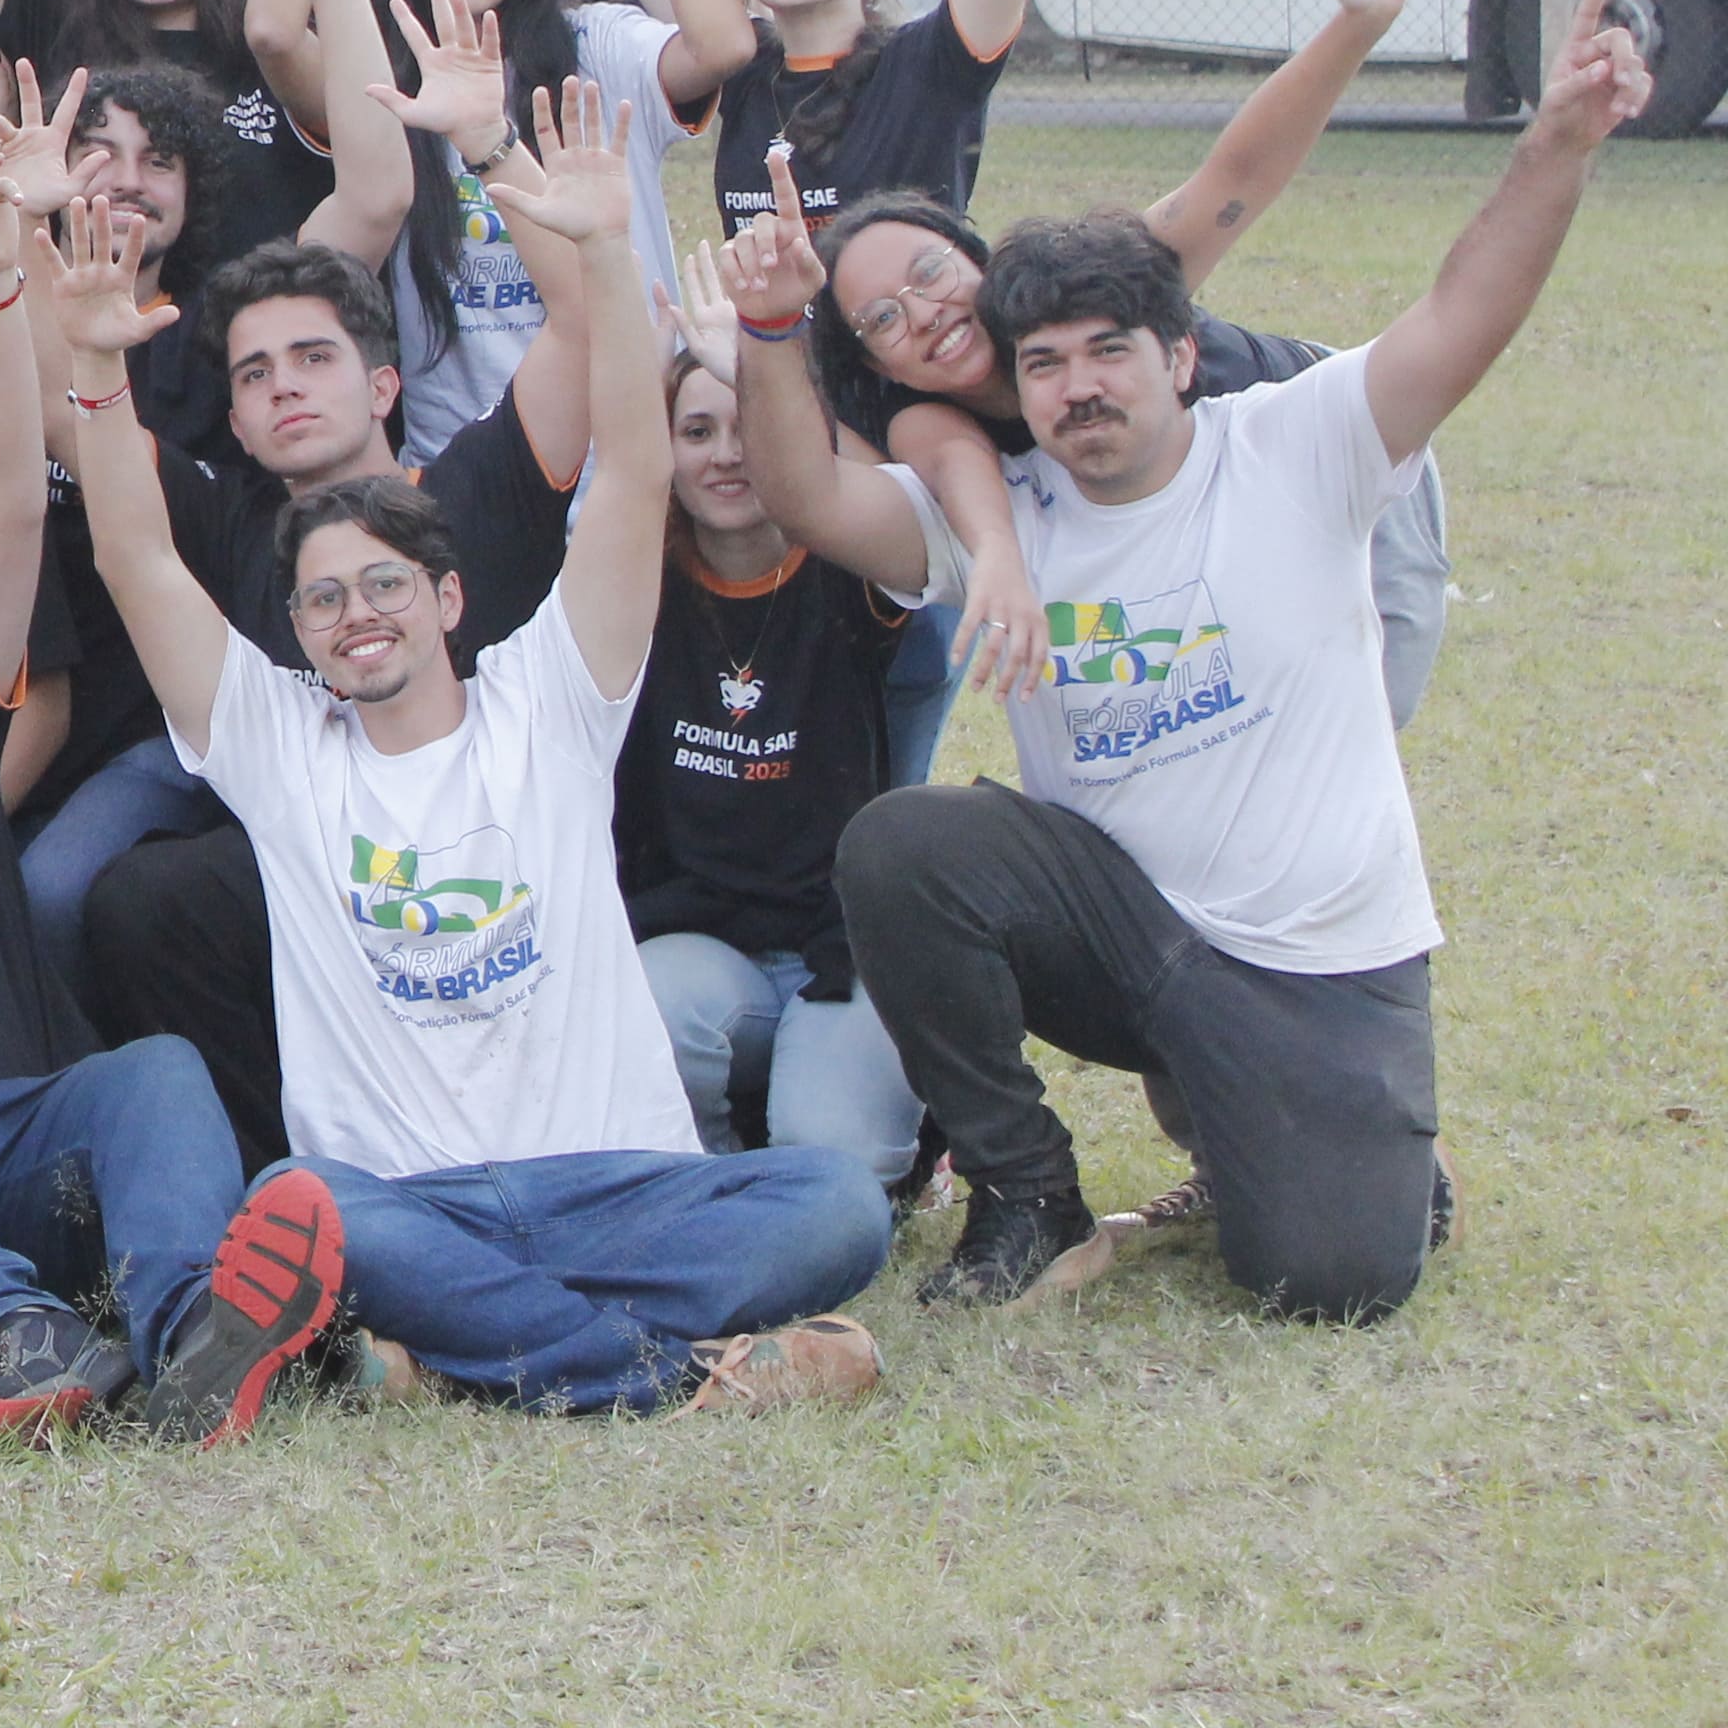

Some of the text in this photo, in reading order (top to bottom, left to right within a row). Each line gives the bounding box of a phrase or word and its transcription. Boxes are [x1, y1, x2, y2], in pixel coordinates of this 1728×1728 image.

[802, 188, 839, 208] SAE
[452, 285, 486, 308] AE
[673, 719, 797, 757] FORMULA SAE
[1074, 731, 1136, 762] SAE
[1148, 743, 1199, 769] Fórmula
[1200, 729, 1228, 751] SAE
[1230, 706, 1274, 738] BRASIL
[674, 747, 791, 781] BRASIL 2025
[376, 937, 542, 1002] SAE BRASIL
